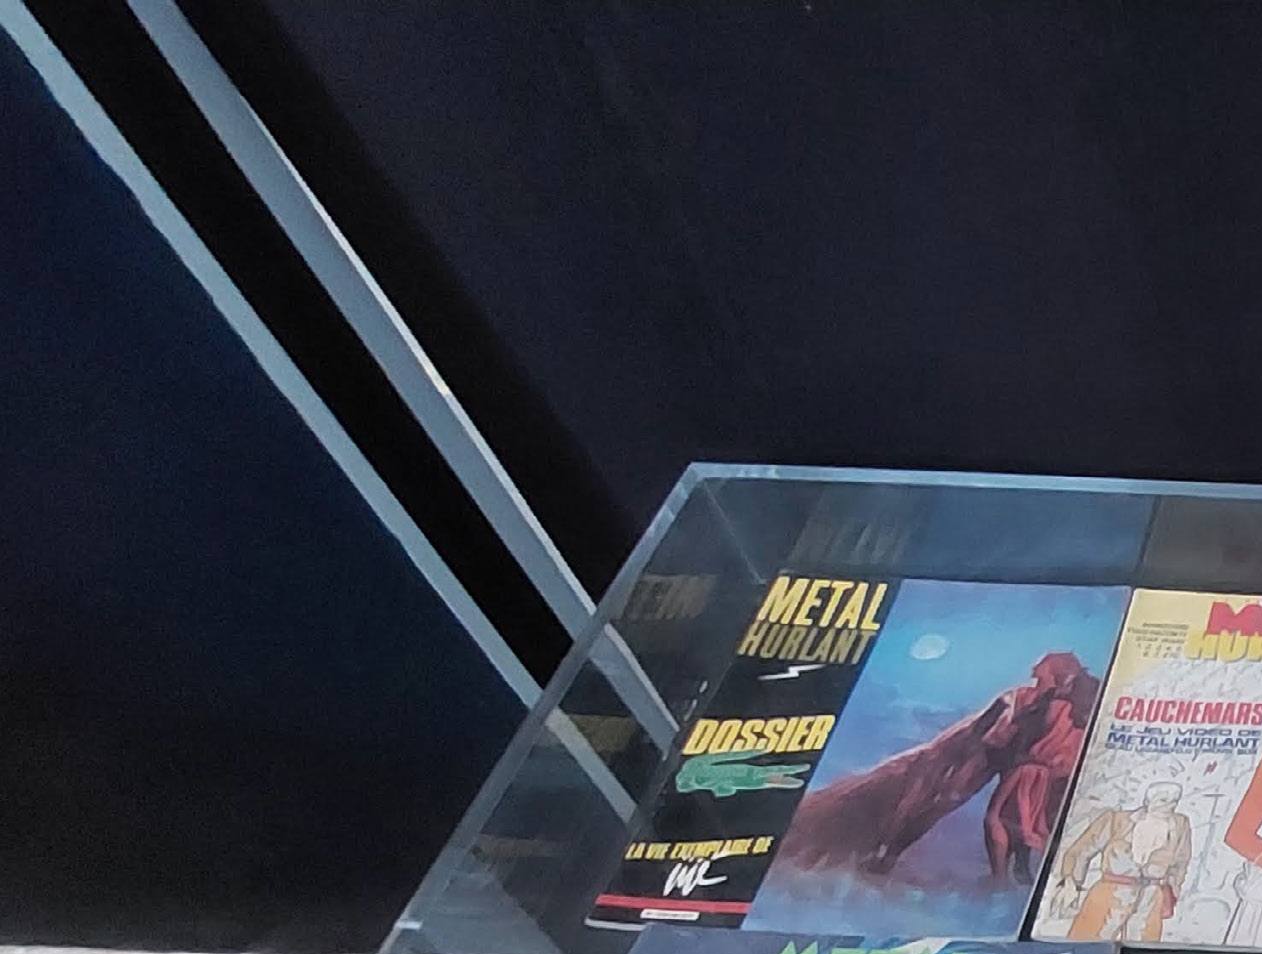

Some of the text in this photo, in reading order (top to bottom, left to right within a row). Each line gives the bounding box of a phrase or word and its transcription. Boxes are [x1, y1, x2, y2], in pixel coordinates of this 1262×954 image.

[757, 575, 888, 631] METAL
[737, 624, 877, 665] HURLANT
[681, 714, 836, 756] DOSSIER
[1107, 731, 1170, 746] METAL
[1174, 736, 1260, 749] HURLANT
[1136, 726, 1171, 736] JEU
[625, 843, 646, 860] LA
[752, 836, 775, 854] DE
